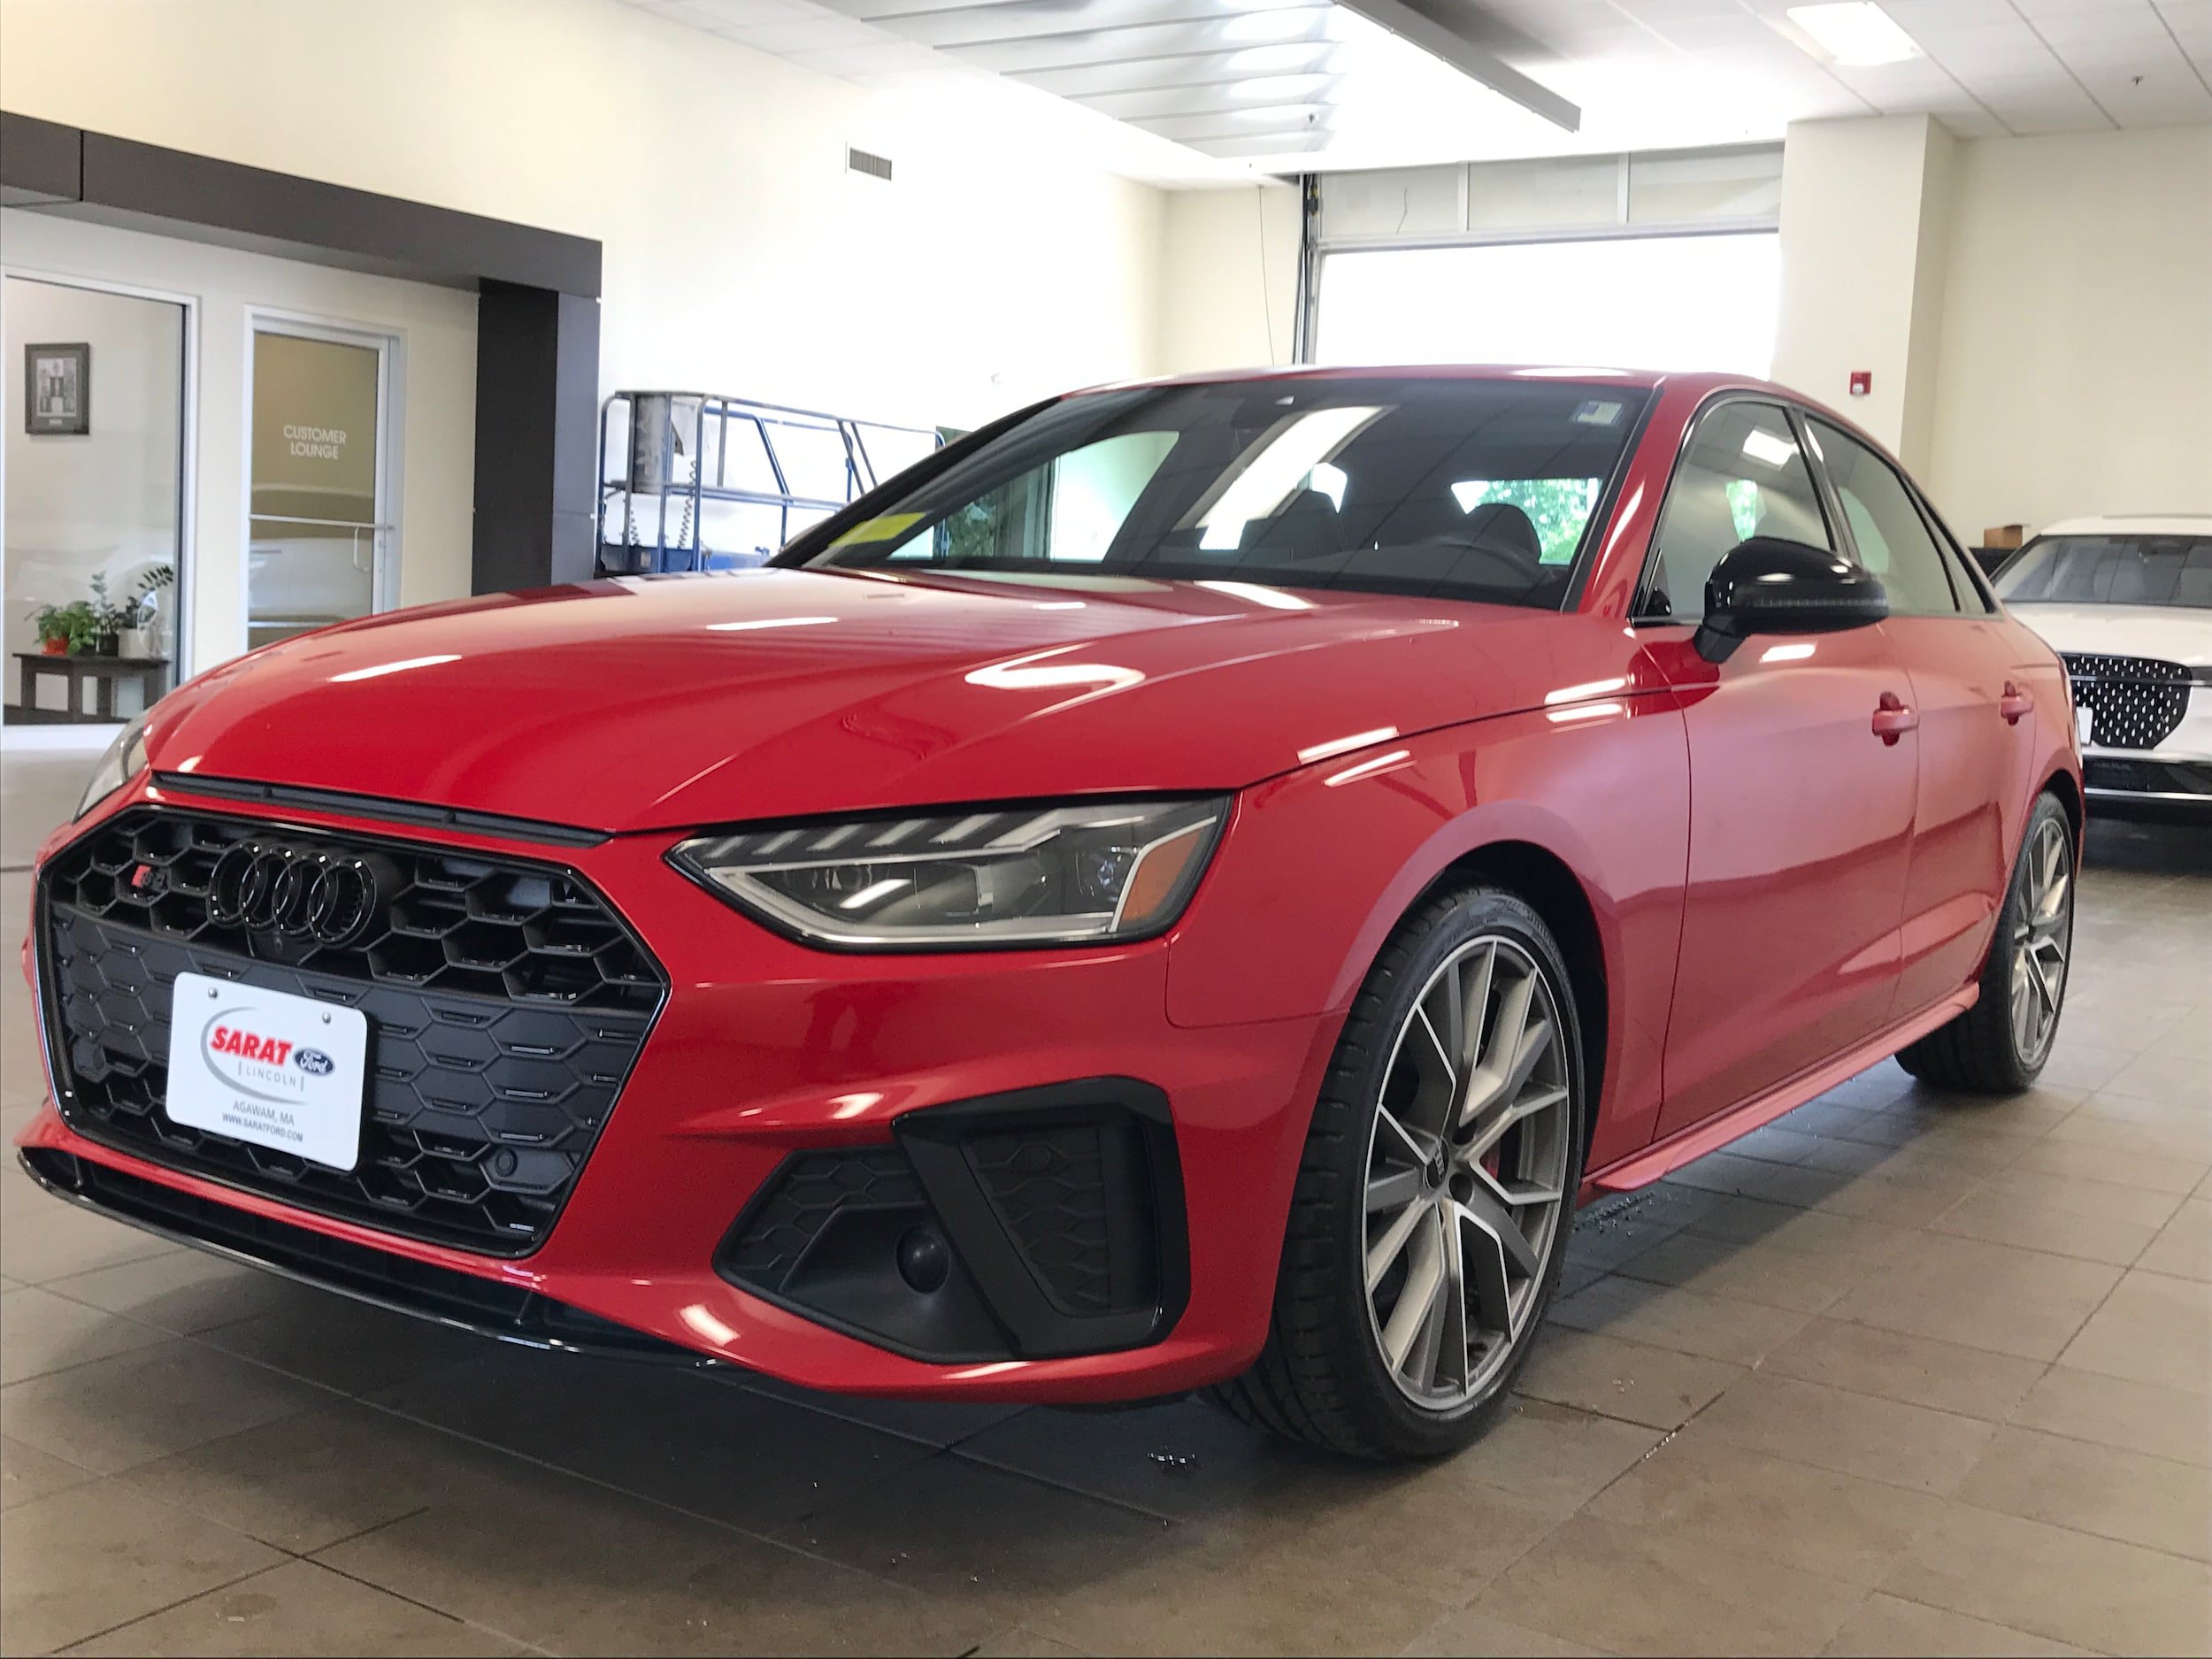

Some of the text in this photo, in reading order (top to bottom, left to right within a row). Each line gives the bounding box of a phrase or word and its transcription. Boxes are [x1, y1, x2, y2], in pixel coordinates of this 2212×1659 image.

[283, 425, 346, 444] CUSTOMER
[290, 441, 339, 460] LOUNGE
[211, 1025, 293, 1066] SARAT
[297, 1048, 331, 1075] Ford
[246, 1065, 296, 1087] LINCOLN
[233, 1100, 295, 1126] AGAWAM, MA
[222, 1112, 303, 1142] WWW.SARATFORD.COM
